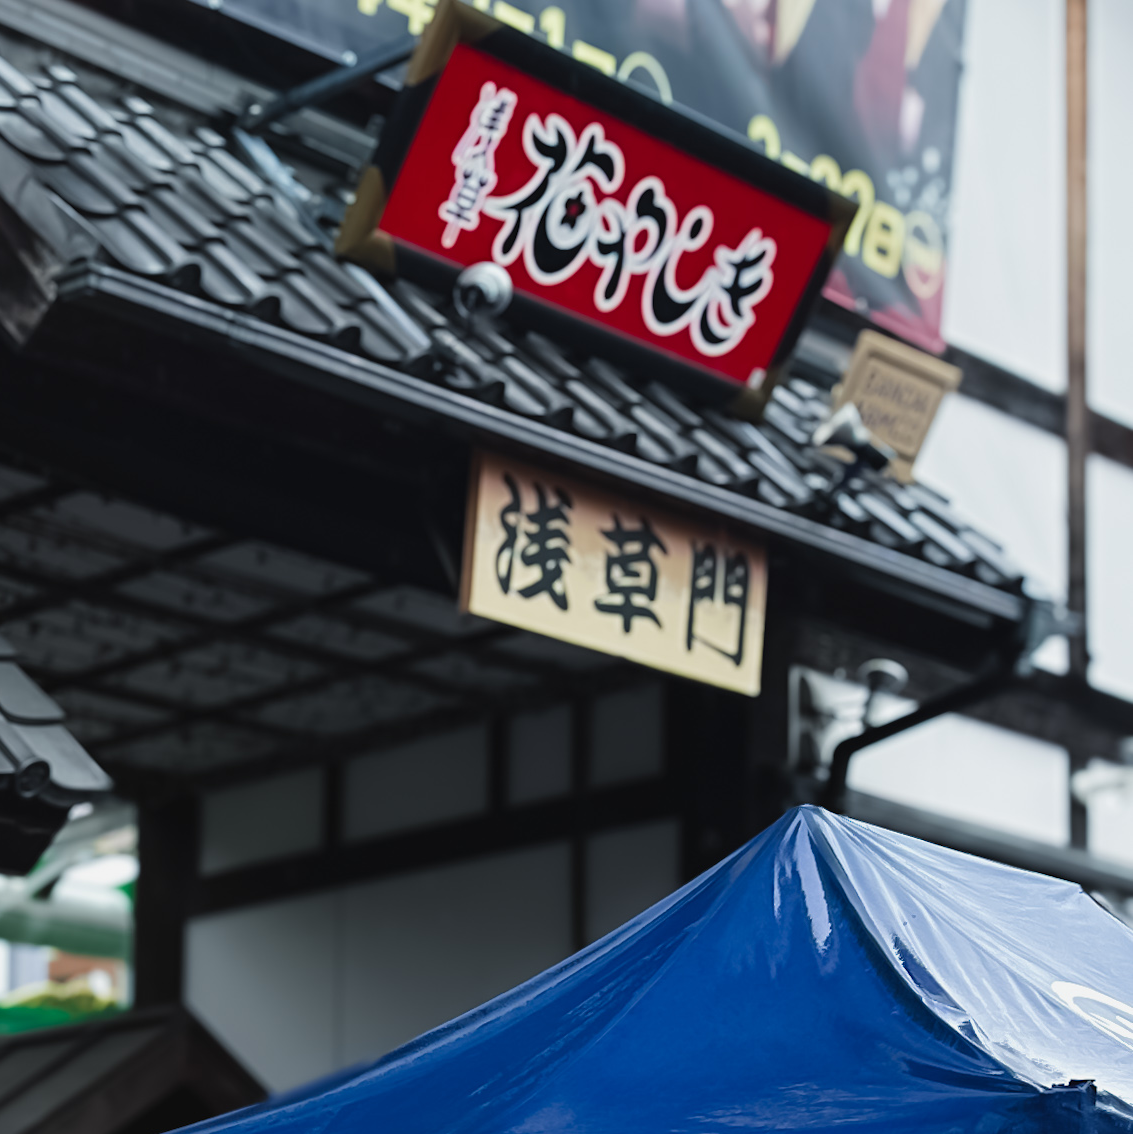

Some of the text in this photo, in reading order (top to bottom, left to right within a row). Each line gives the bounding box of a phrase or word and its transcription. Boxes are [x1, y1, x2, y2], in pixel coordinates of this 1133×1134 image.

[483, 112, 777, 357] 花やしき
[496, 471, 749, 667] 浅草門
